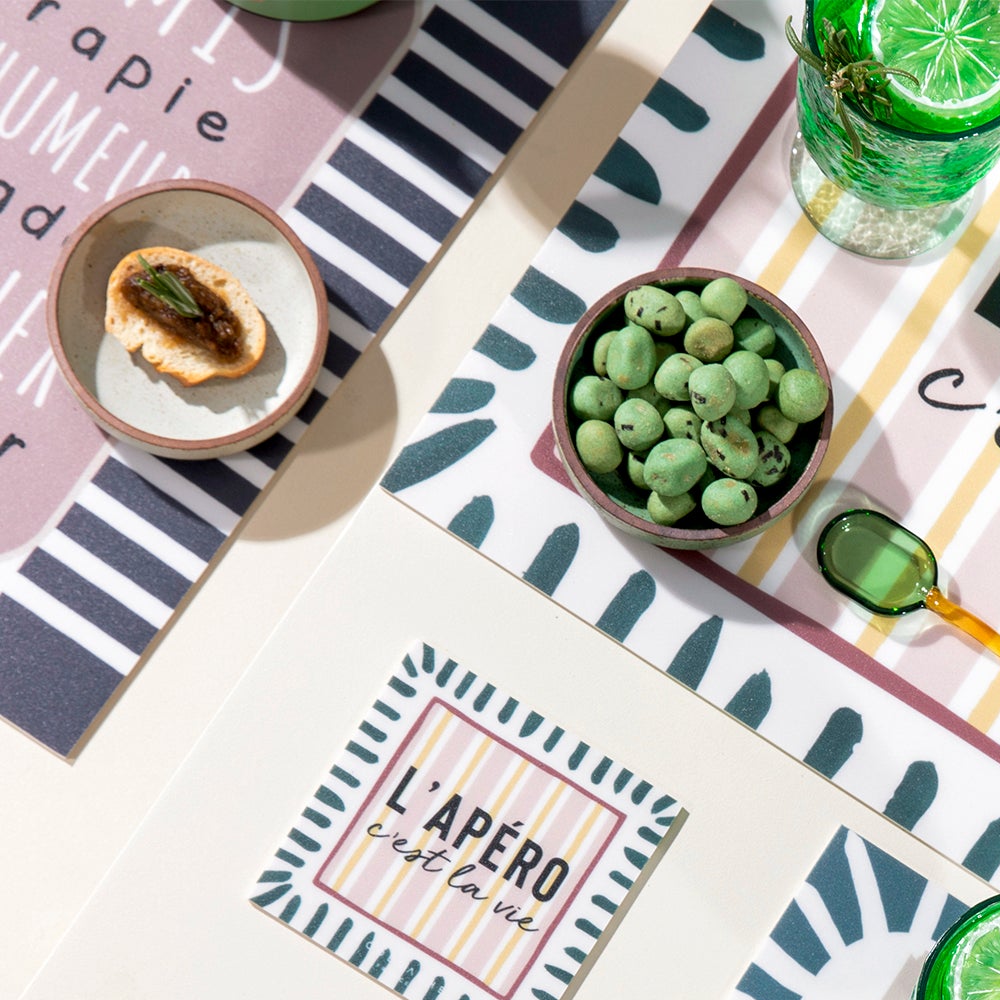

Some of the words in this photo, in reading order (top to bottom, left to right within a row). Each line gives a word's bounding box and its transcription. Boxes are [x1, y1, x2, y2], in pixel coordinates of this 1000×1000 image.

[365, 820, 453, 874] c'est
[446, 862, 490, 902] la
[491, 898, 540, 934] vie
[384, 764, 572, 904] L'APÉRO
